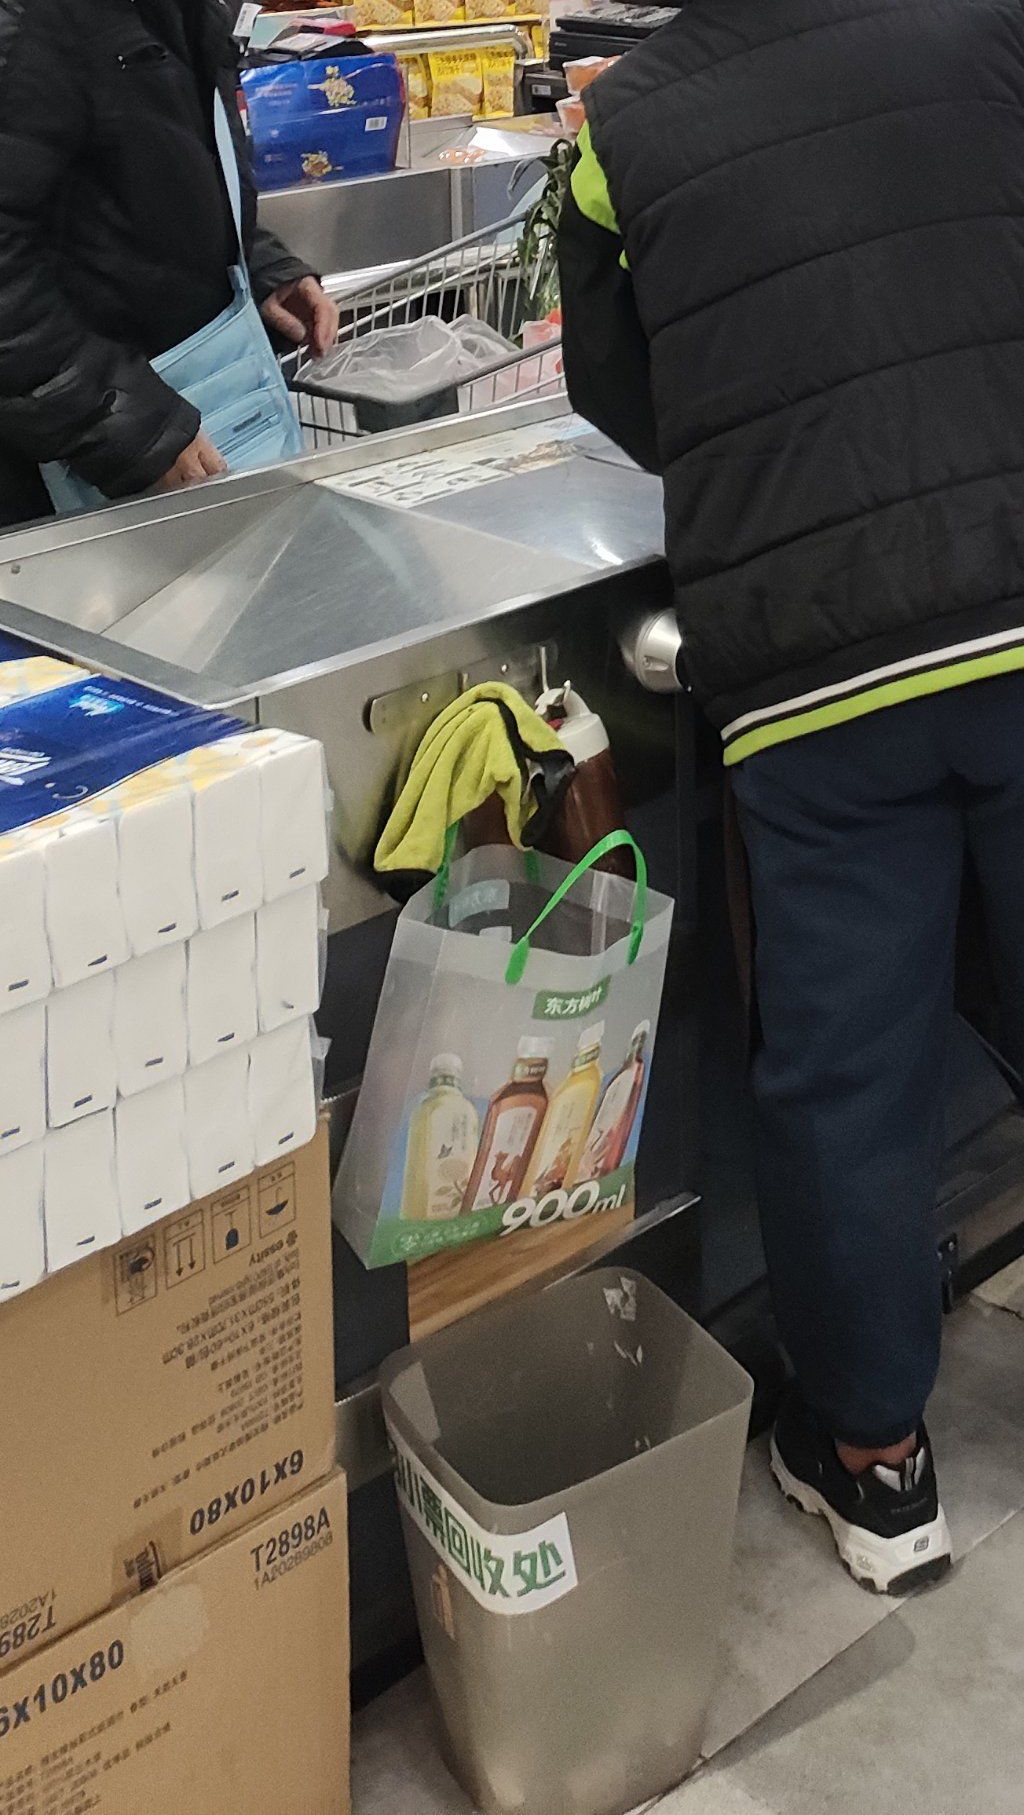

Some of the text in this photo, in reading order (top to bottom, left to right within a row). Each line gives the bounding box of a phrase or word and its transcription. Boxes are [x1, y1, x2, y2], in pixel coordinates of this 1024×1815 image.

[543, 986, 603, 1016] 东方树叶
[501, 1180, 626, 1236] 900ml
[250, 1506, 330, 1573] T2898A
